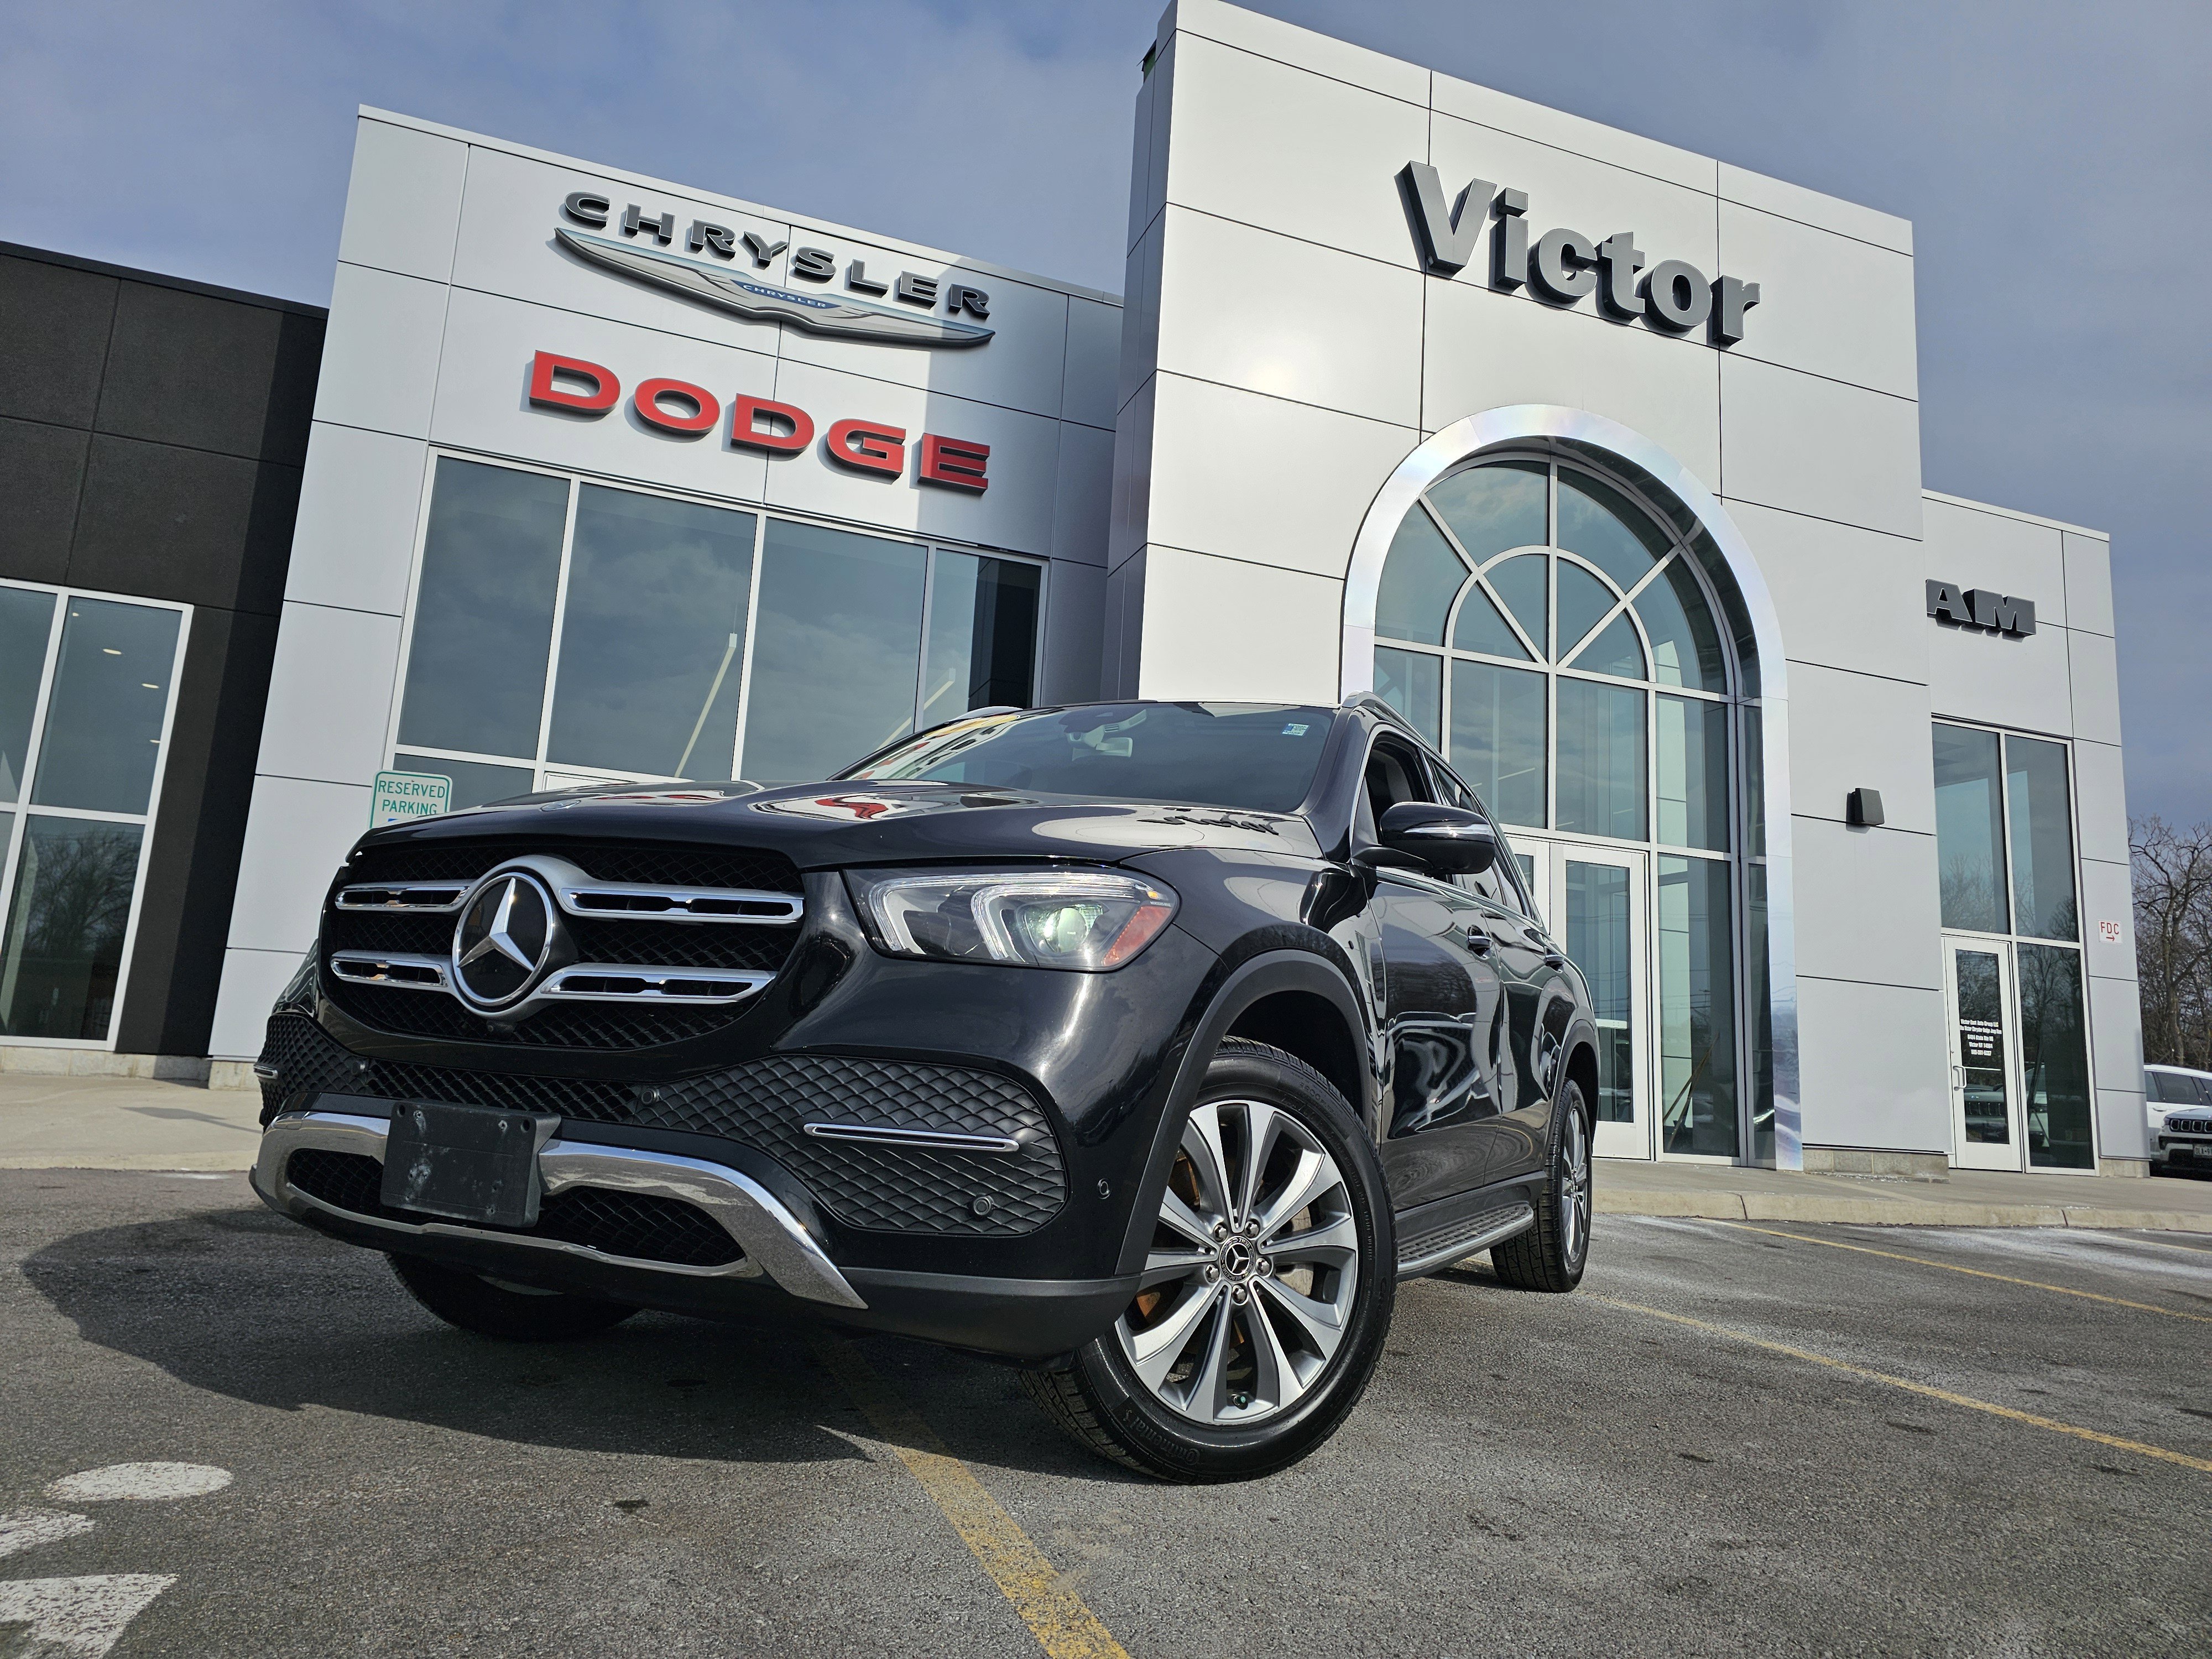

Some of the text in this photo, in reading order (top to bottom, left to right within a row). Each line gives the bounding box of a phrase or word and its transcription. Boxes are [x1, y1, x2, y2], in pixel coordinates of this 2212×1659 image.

[564, 191, 990, 319] CHRYSLER
[1394, 160, 1760, 345] Victor
[743, 285, 826, 307] CHRYSLER
[529, 350, 990, 494] DODGE
[378, 780, 445, 798] RESERVED
[382, 799, 437, 815] PARKING
[2100, 922, 2119, 935] FDC
